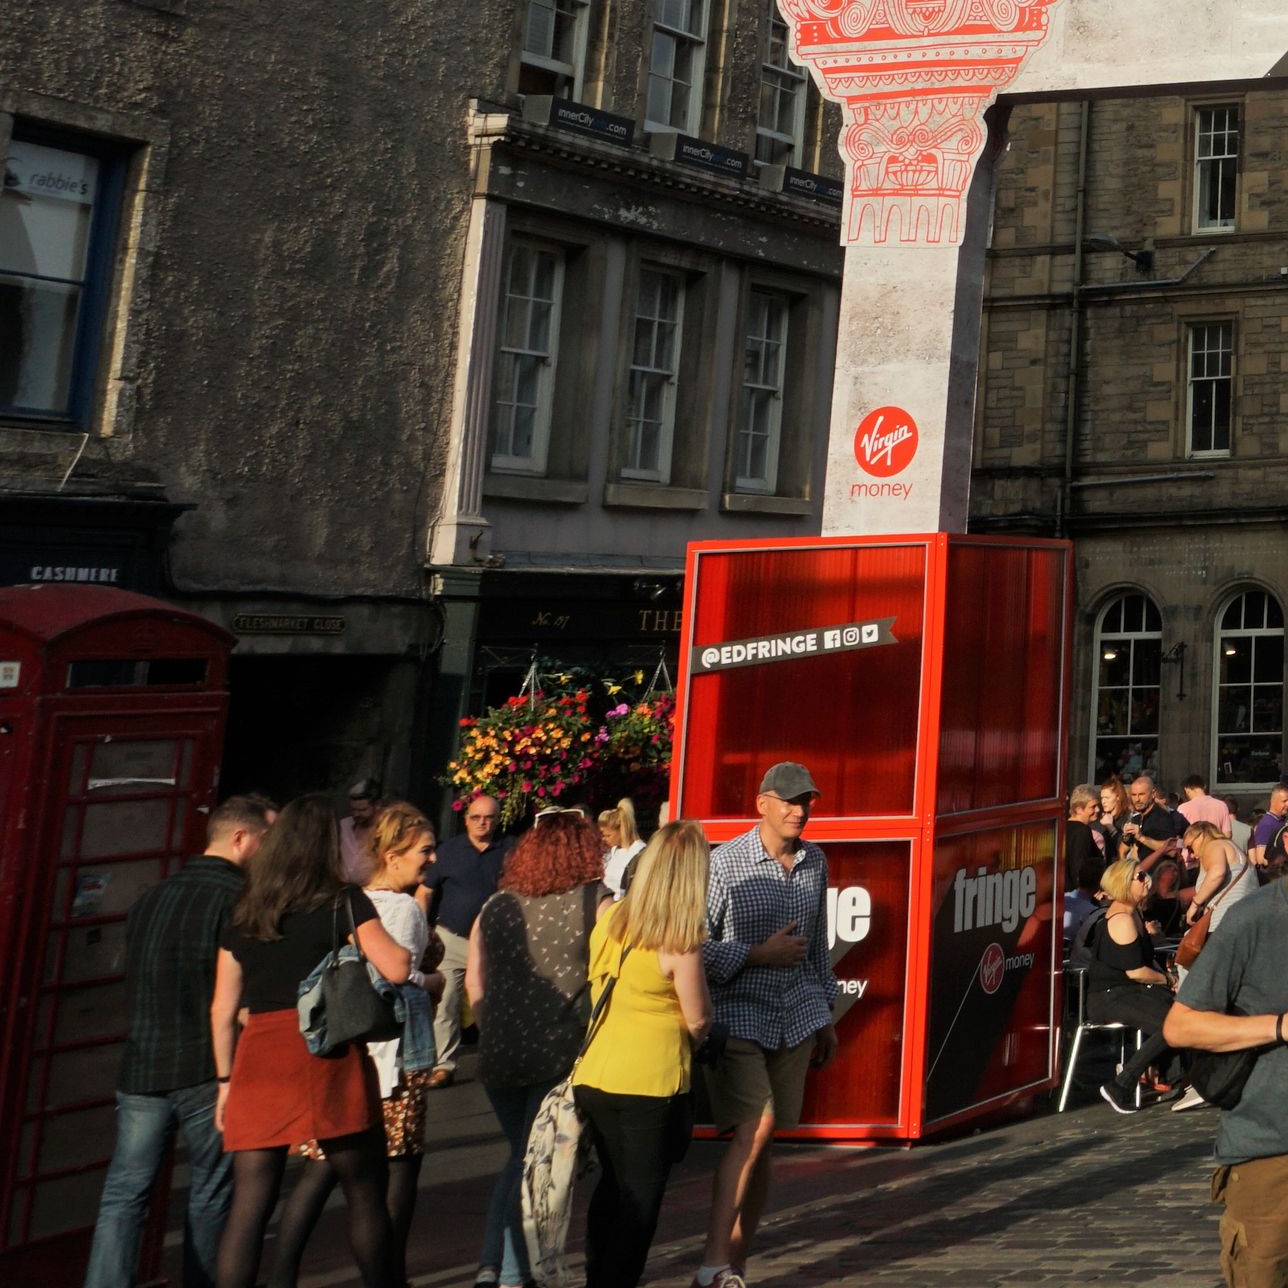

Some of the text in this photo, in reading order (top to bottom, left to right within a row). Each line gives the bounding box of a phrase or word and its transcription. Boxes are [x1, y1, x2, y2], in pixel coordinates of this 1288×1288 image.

[30, 171, 88, 194] rabbie's
[860, 415, 913, 466] Virgin
[850, 482, 913, 501] money
[29, 566, 121, 583] CASHMERE
[701, 633, 818, 669] @EDFRINGE
[953, 865, 1037, 934] fringe
[982, 949, 1035, 987] Virgin money
[837, 979, 868, 999] ney
